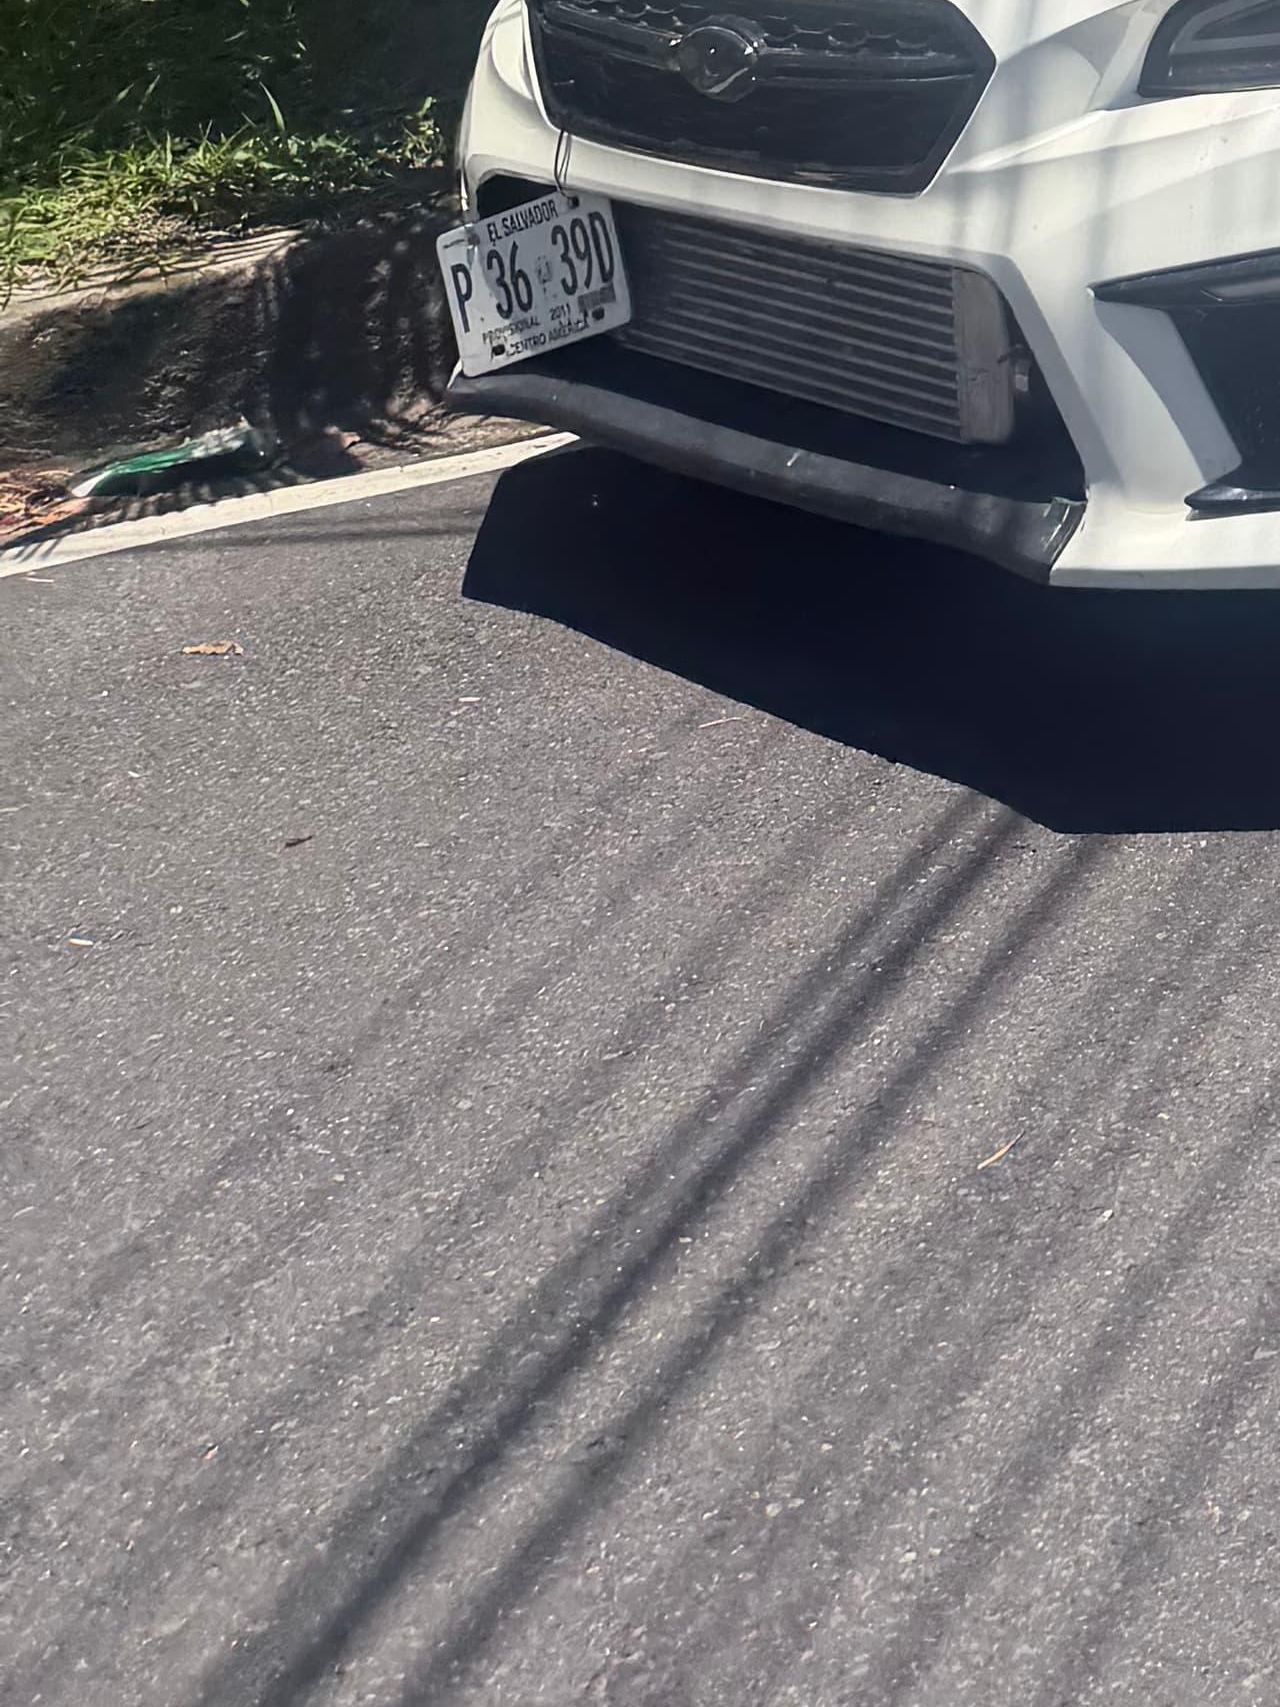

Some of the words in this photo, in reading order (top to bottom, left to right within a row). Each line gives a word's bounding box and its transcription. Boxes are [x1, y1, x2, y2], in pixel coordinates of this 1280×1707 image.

[487, 223, 503, 245] EL
[503, 199, 559, 236] SALVADOR
[450, 262, 473, 333] P
[486, 241, 534, 320] 36
